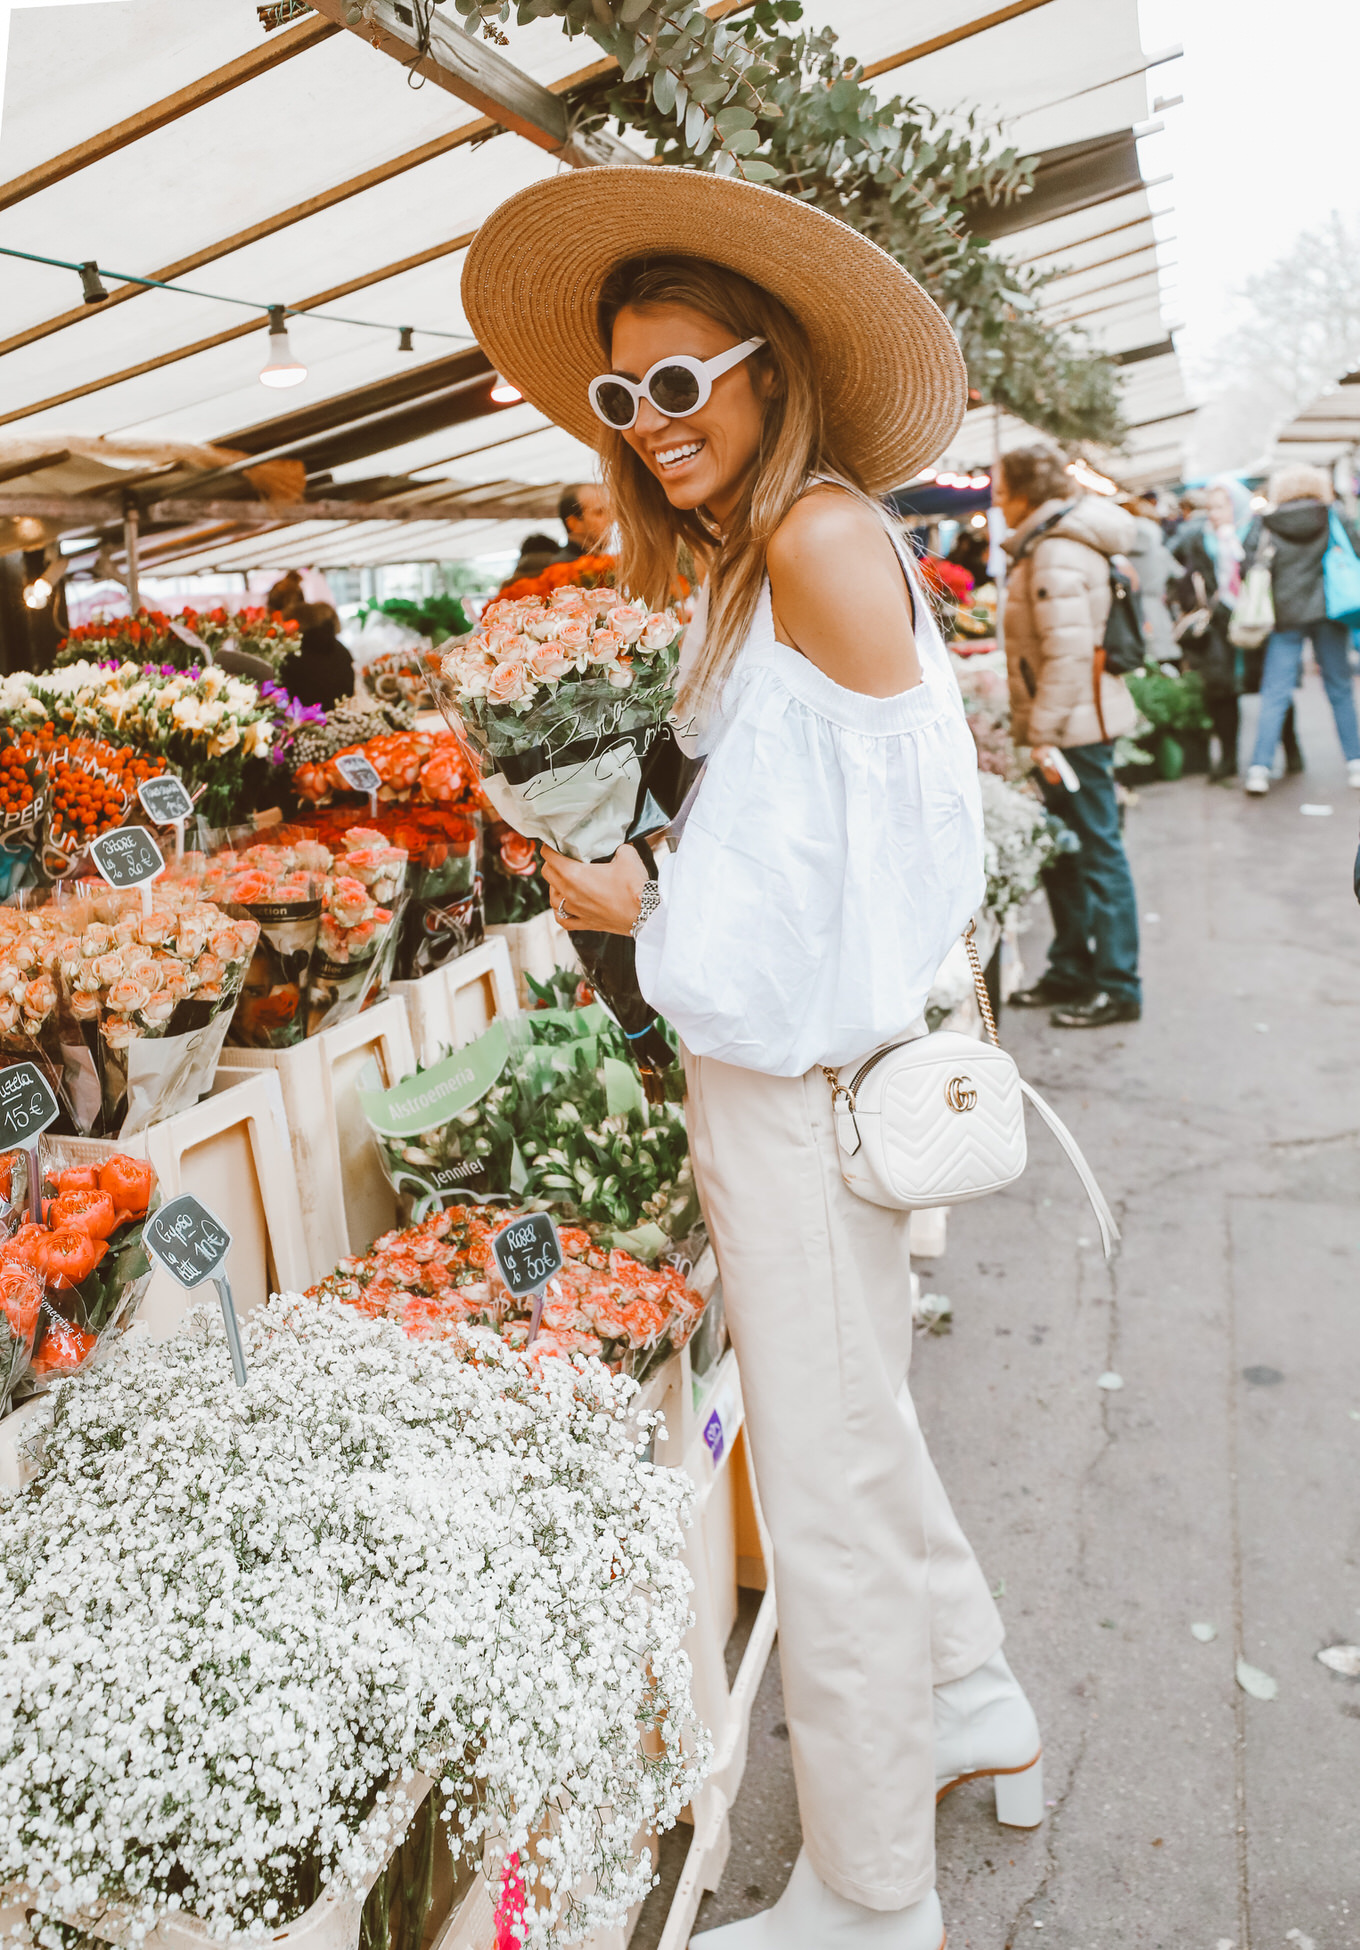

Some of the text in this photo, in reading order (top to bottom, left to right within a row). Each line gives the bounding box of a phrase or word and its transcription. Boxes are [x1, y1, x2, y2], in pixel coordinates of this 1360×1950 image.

[4, 1092, 43, 1132] 15€
[388, 1067, 476, 1121] Alstroemeria
[431, 1158, 485, 1188] Jennifer
[523, 1241, 556, 1280] 30€
[41, 1293, 75, 1338] ioneering
